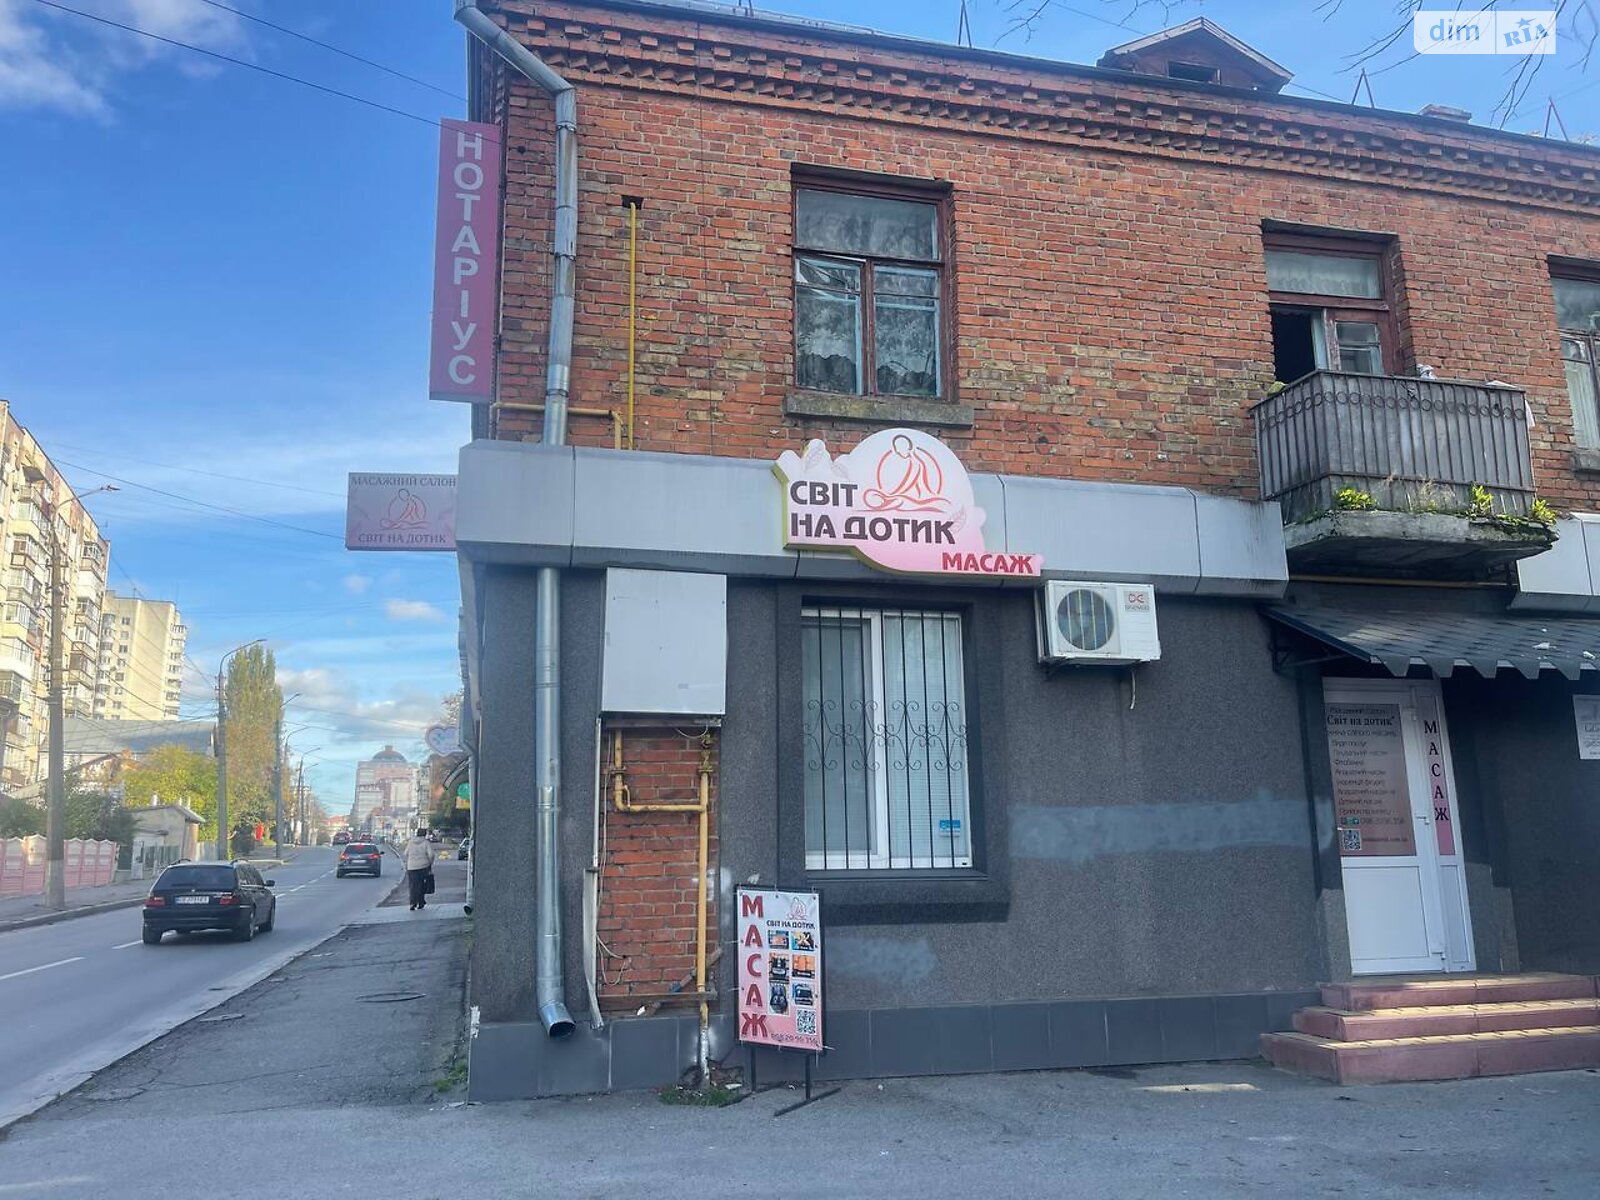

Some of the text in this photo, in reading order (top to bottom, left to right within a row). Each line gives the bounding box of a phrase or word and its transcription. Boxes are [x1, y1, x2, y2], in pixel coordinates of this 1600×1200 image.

[447, 132, 484, 385] НОТАРІУС
[350, 475, 456, 487] МАСАЖНИЙ САЛОН
[790, 480, 858, 507] СВІТ
[358, 533, 446, 544] СВІТ НА ДОТИК
[790, 512, 956, 545] НА ДОТИК
[942, 551, 1033, 574] МАСАЖ
[1424, 720, 1450, 821] МАСАЖ
[741, 894, 768, 1038] МАСАЖ
